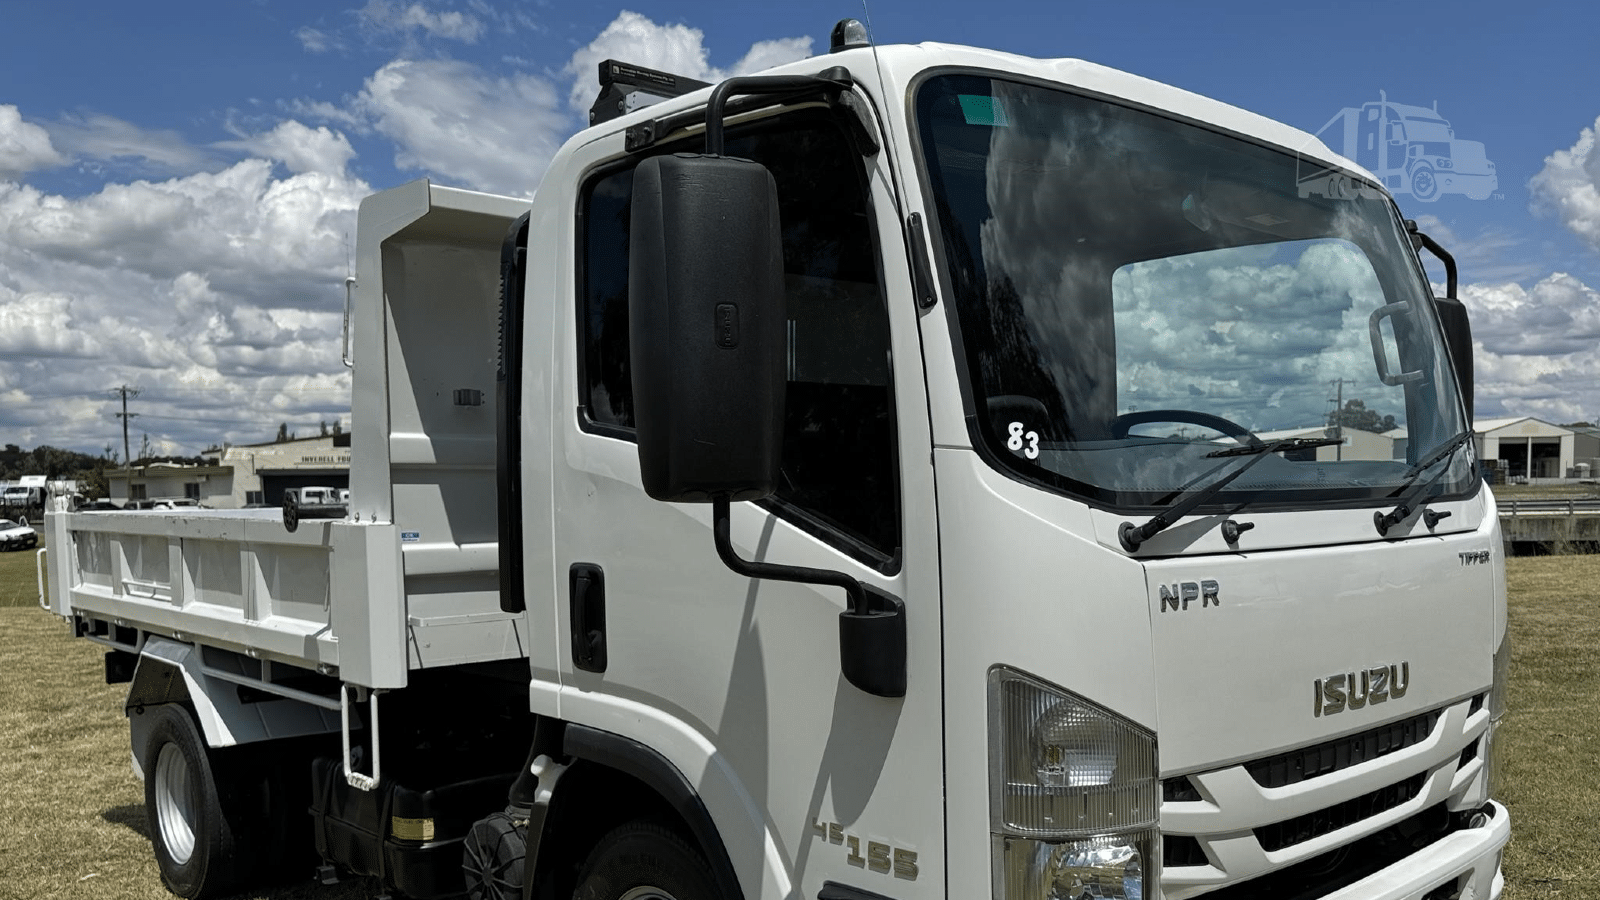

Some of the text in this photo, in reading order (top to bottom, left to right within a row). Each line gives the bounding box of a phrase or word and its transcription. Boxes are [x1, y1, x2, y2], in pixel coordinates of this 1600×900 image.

[1007, 421, 1040, 460] 83
[1458, 550, 1490, 566] TIPPER
[1159, 579, 1220, 613] NPR
[1313, 660, 1409, 718] ISUZU
